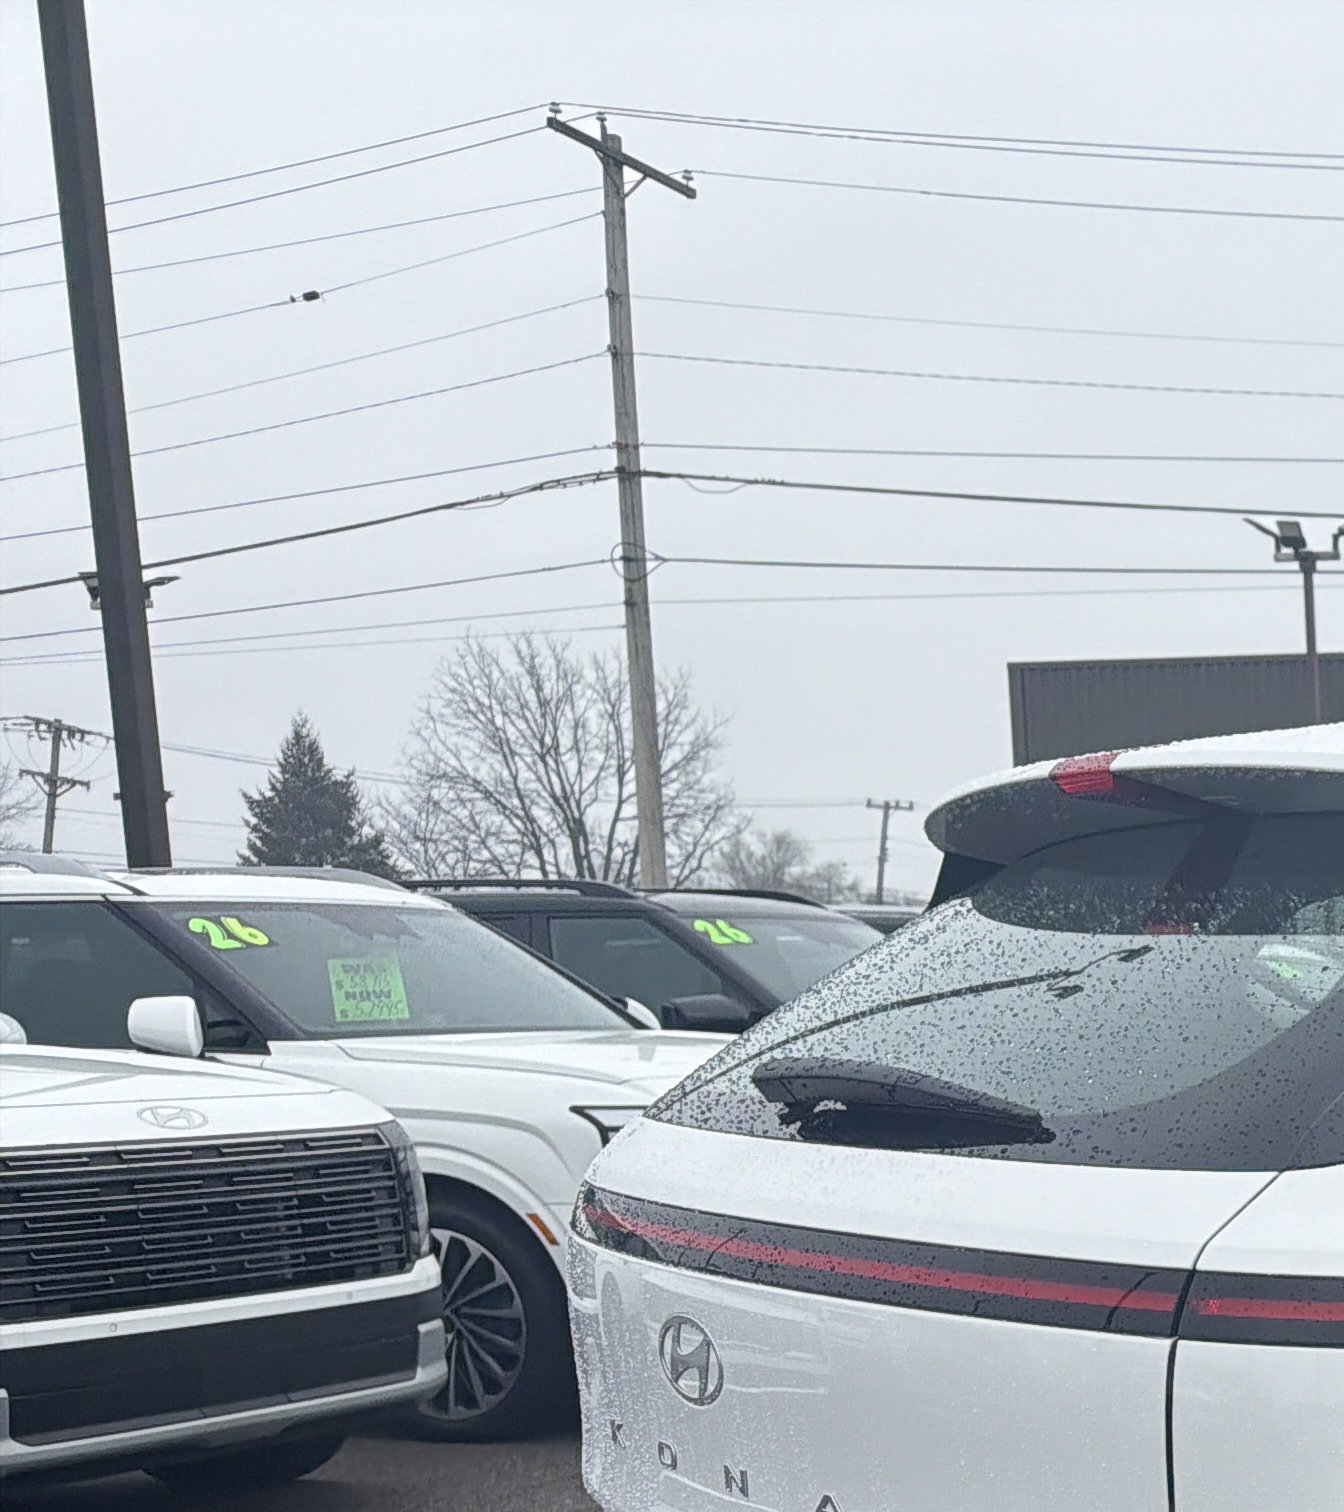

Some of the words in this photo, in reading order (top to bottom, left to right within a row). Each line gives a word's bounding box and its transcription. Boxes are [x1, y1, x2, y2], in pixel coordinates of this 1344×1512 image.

[188, 915, 269, 950] 26
[693, 918, 754, 944] 26
[344, 989, 393, 1002] NOW
